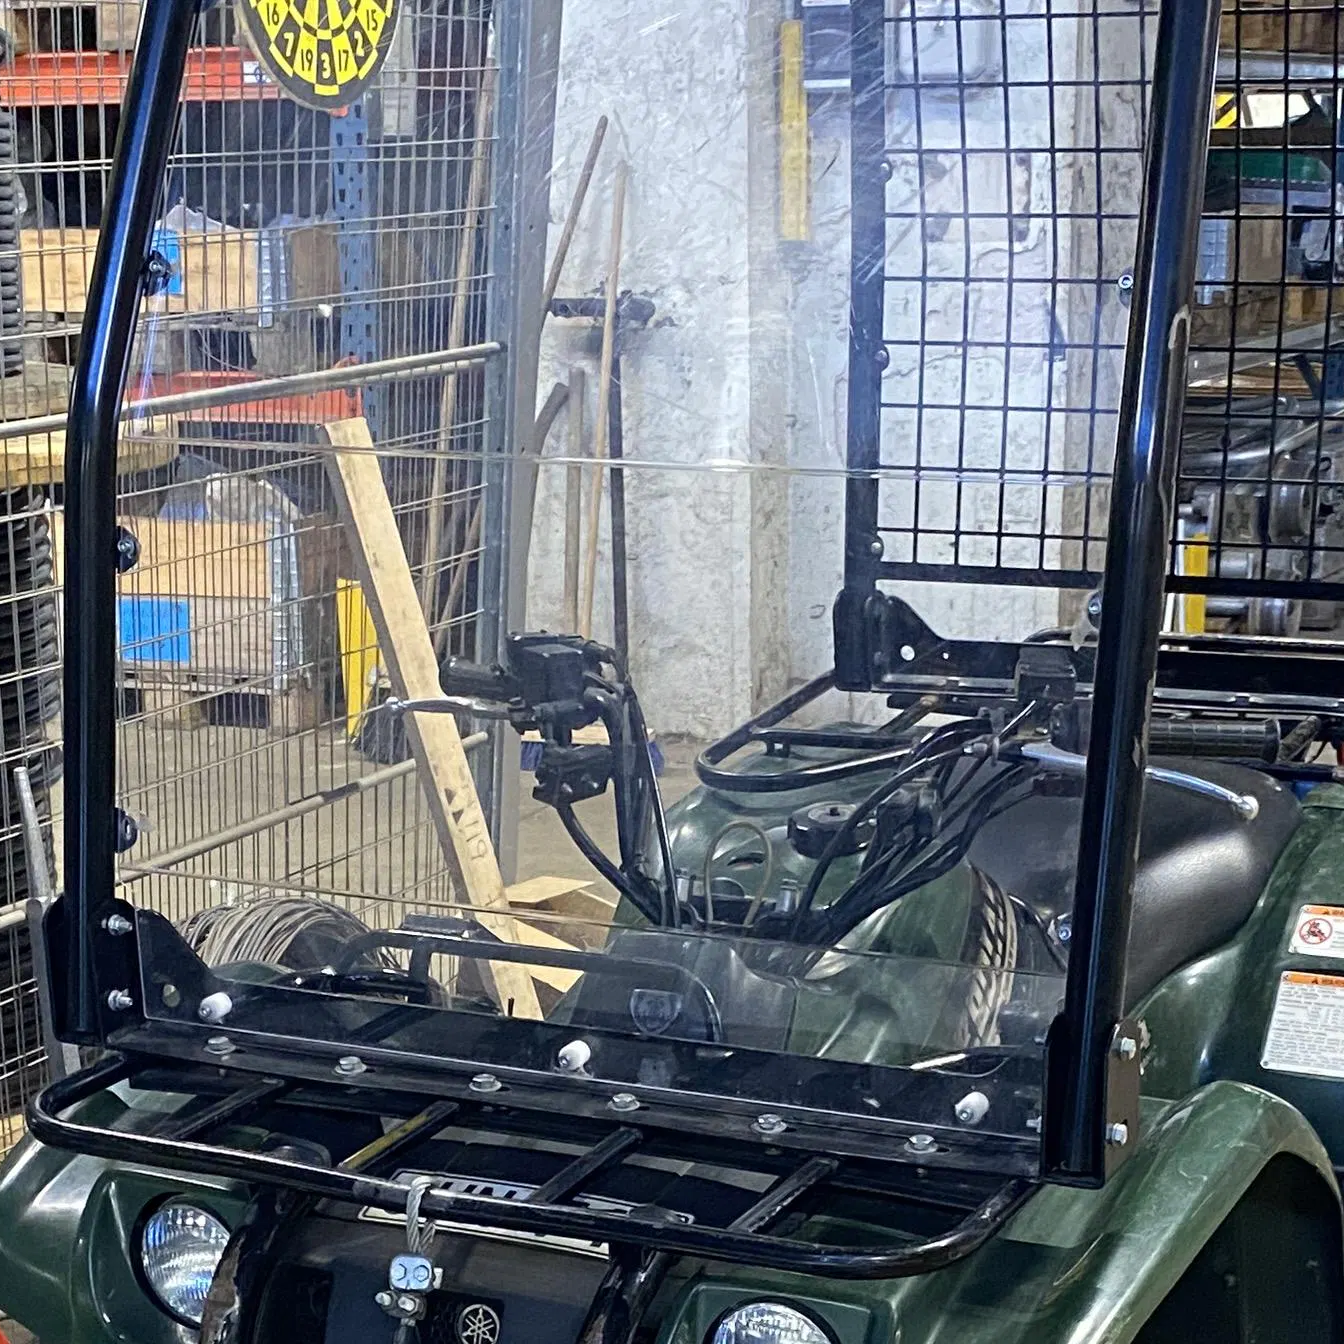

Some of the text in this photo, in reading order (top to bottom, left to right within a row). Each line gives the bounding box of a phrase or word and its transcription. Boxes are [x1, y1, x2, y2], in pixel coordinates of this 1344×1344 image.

[267, 2, 280, 26] 16
[366, 9, 378, 31] 15
[283, 31, 295, 57] 7
[353, 30, 365, 57] 2
[301, 49, 313, 72] 19
[320, 52, 331, 79] 3
[338, 49, 349, 72] 17
